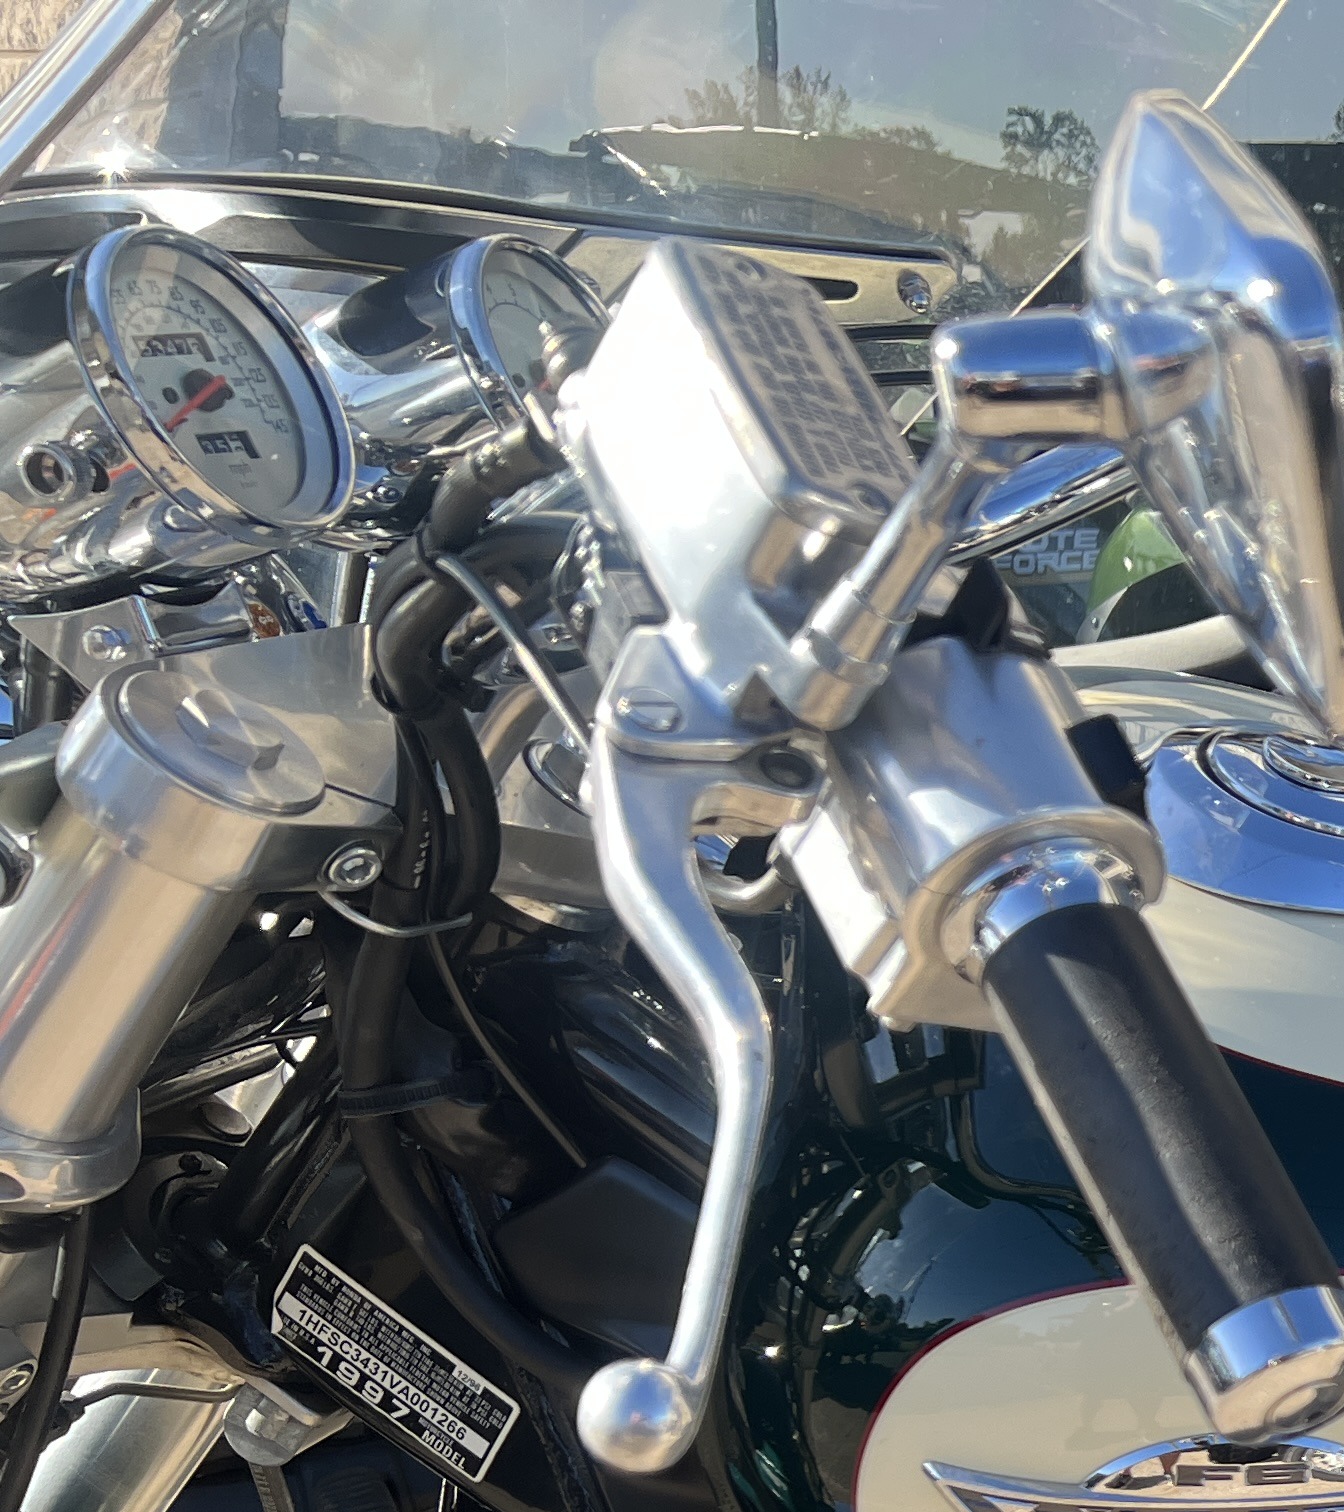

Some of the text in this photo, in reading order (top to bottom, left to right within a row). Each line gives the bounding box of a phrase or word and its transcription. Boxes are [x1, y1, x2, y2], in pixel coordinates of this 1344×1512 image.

[993, 549, 1100, 575] FORCE
[294, 1306, 469, 1441] 1HFSC3431VA001266
[310, 1342, 411, 1423] 1997
[419, 1428, 469, 1470] MODEL
